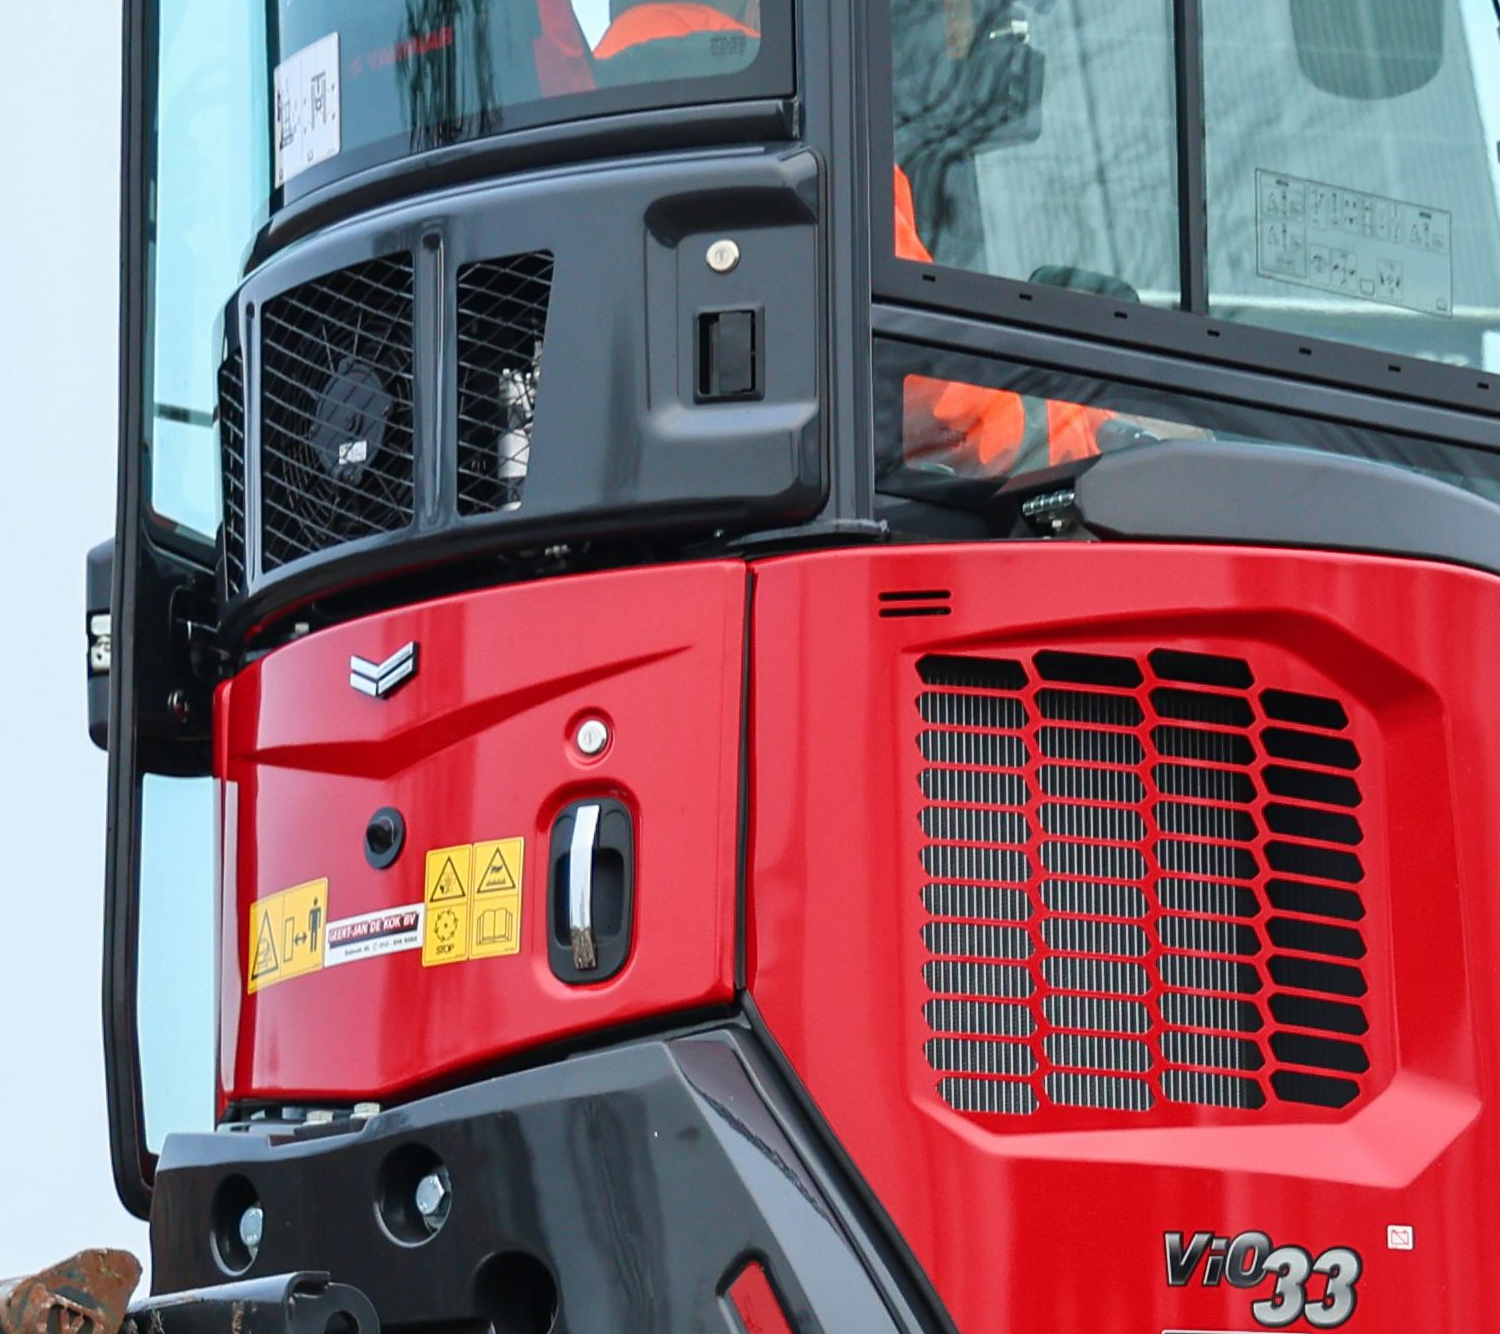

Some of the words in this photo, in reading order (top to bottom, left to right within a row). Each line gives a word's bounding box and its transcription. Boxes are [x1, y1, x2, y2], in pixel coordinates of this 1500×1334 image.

[370, 919, 381, 933] DE
[382, 915, 401, 930] KOK
[403, 912, 417, 927] BV
[436, 943, 454, 955] STOP
